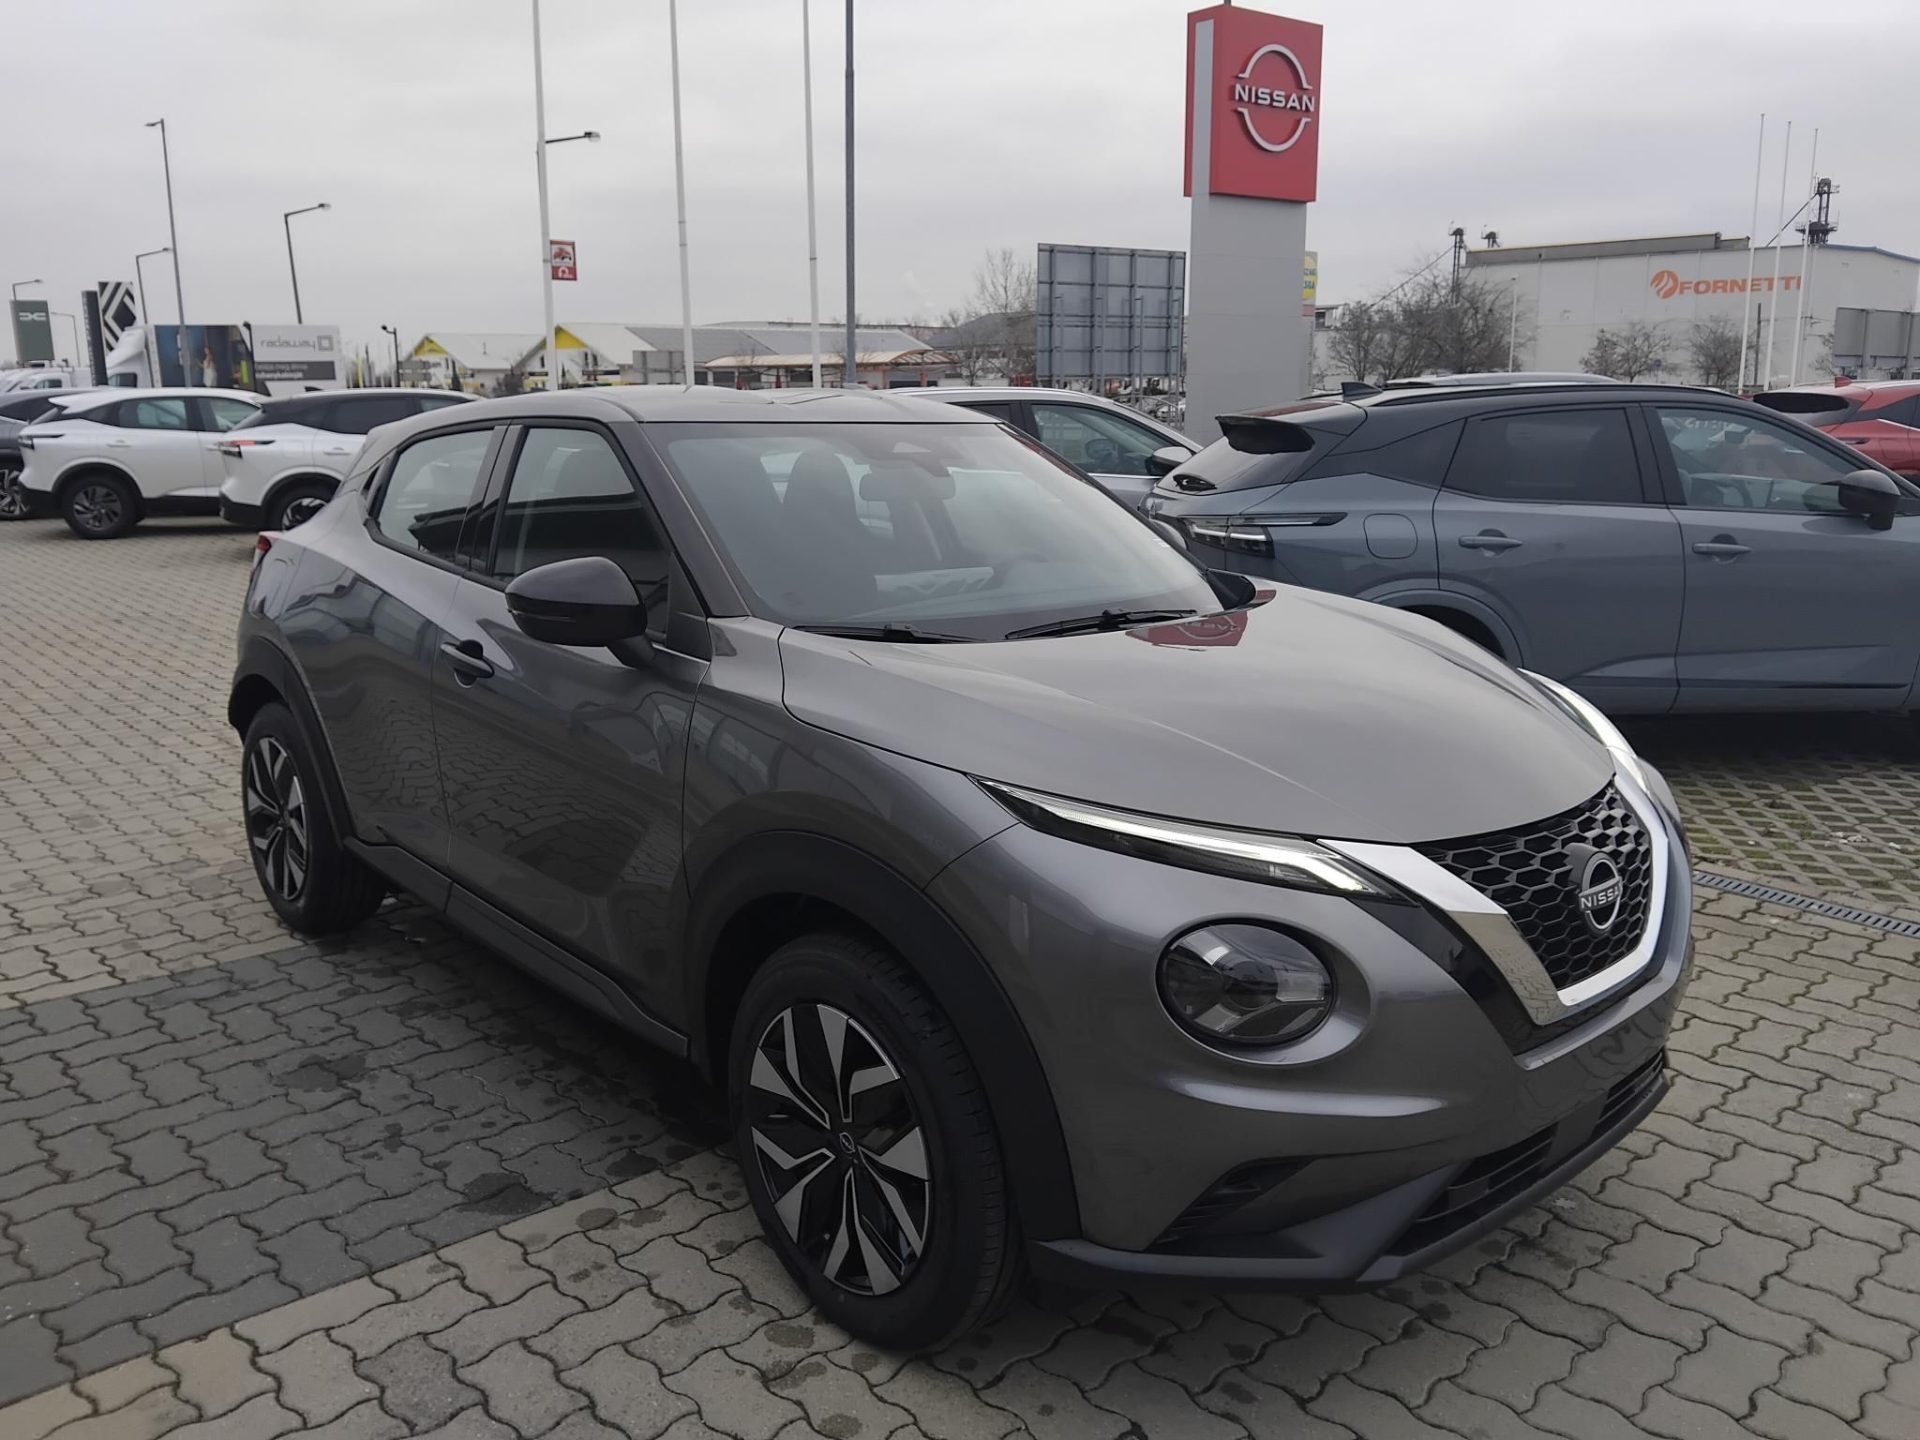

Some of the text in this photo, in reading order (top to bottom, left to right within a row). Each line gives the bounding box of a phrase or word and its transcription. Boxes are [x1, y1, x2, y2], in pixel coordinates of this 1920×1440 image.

[1235, 83, 1315, 112] NISSAN
[1679, 275, 1802, 295] FORNETTI
[261, 335, 316, 352] radaway
[1581, 884, 1620, 909] NISS
